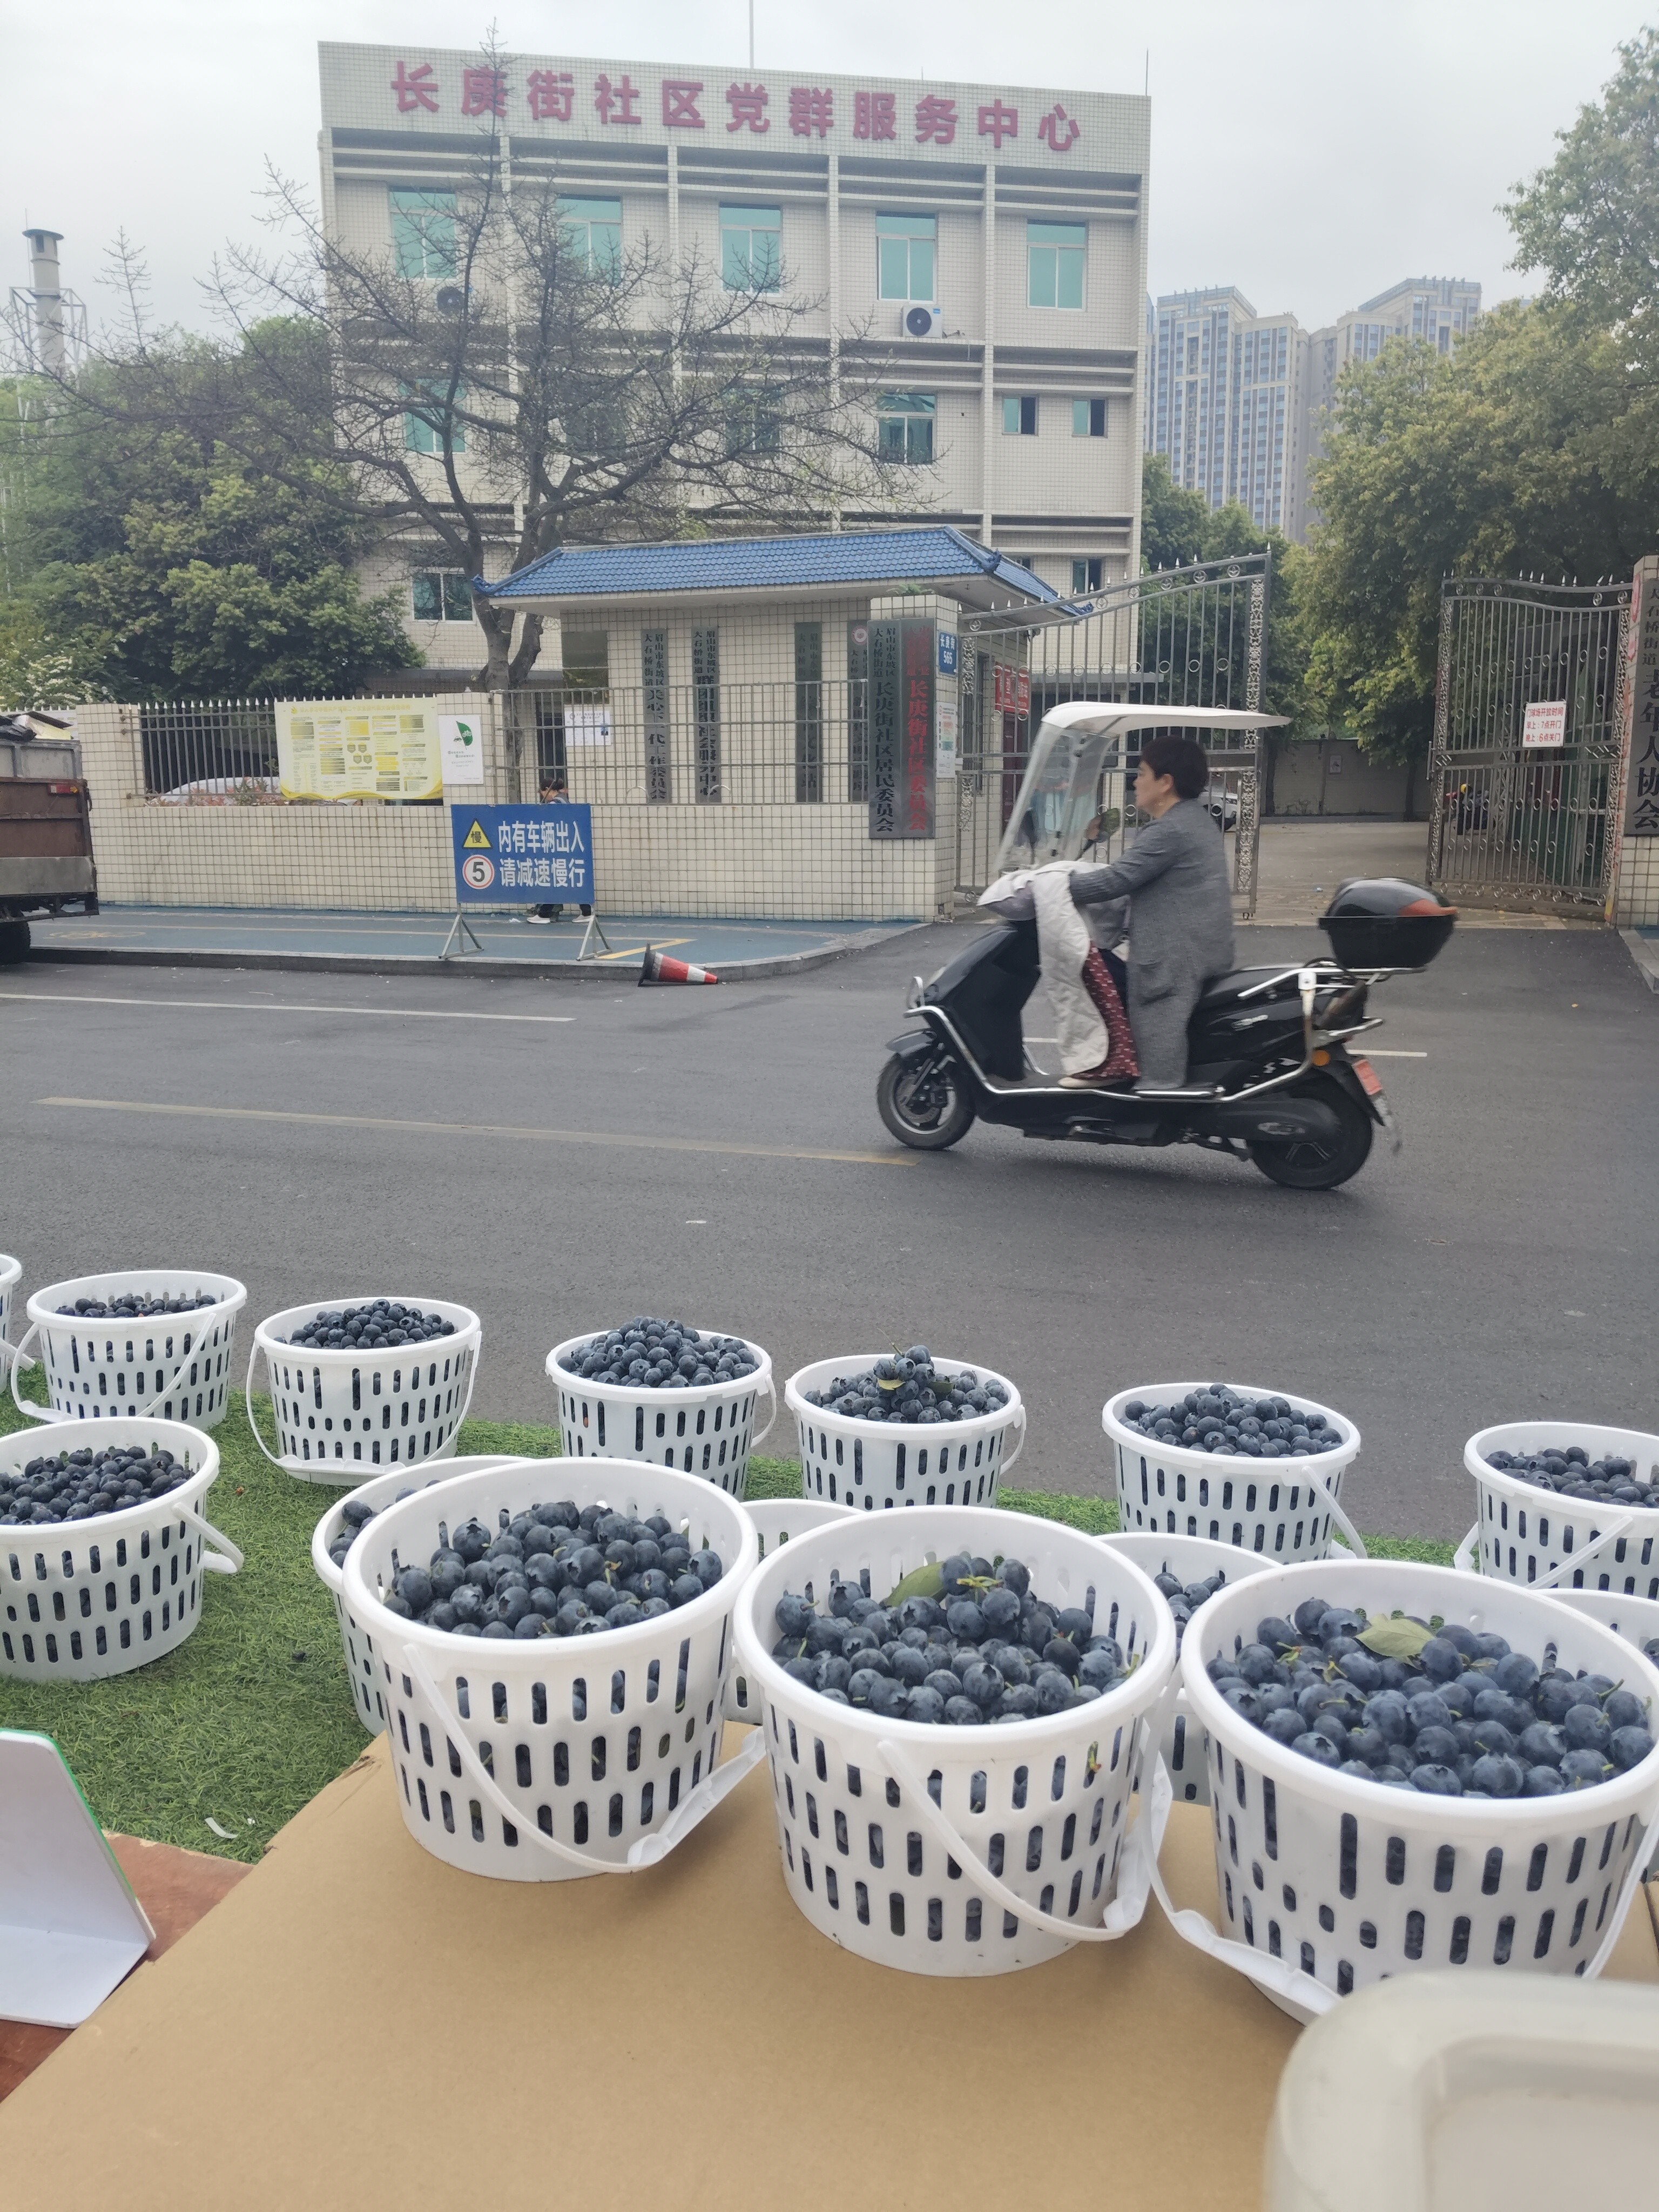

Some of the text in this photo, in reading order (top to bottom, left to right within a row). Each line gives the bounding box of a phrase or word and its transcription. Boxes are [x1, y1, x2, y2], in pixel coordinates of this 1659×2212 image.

[391, 60, 1080, 151] 长庚街社区党群服务中心
[1526, 707, 1564, 718] 门球场开放时间
[874, 682, 895, 832] 长庚街社区居民委员会
[907, 679, 929, 831] 长庚街社区委员会
[1633, 669, 1659, 829] 老年人协会
[470, 830, 482, 845] 慢
[498, 820, 584, 853] 内有车辆出入
[472, 861, 485, 883] 5
[500, 858, 585, 888] 请减速慢行
